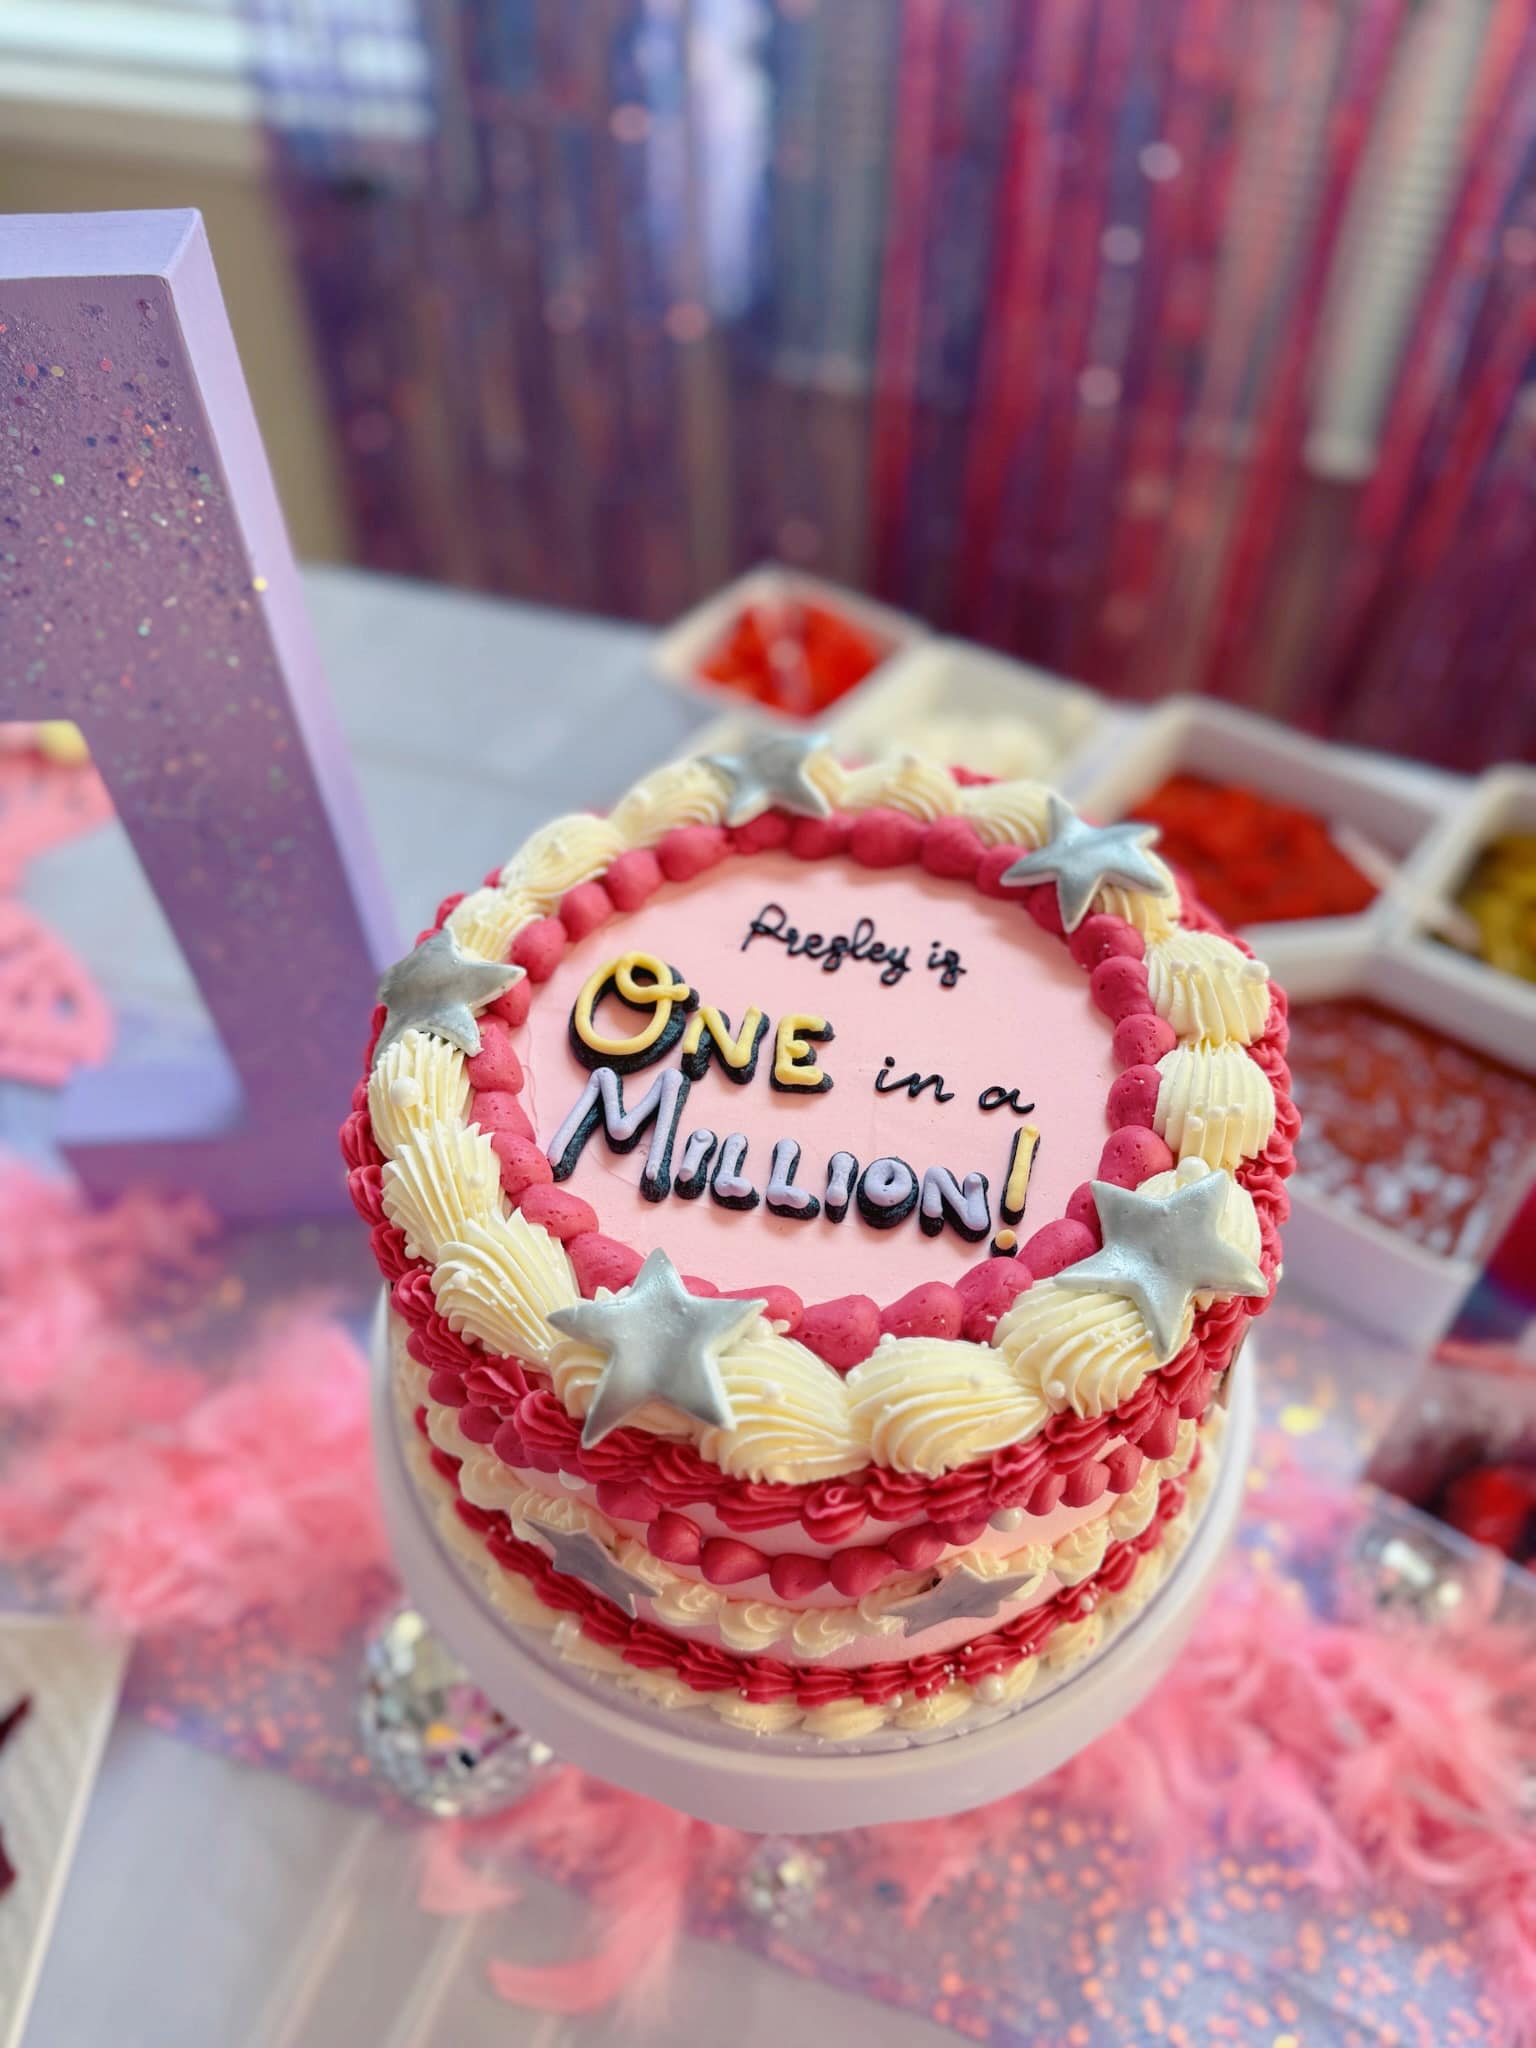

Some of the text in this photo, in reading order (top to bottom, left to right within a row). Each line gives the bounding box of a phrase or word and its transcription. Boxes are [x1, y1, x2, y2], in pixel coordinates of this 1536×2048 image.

[568, 951, 1035, 1114] ONE in a
[547, 1066, 1040, 1258] MILLION!
